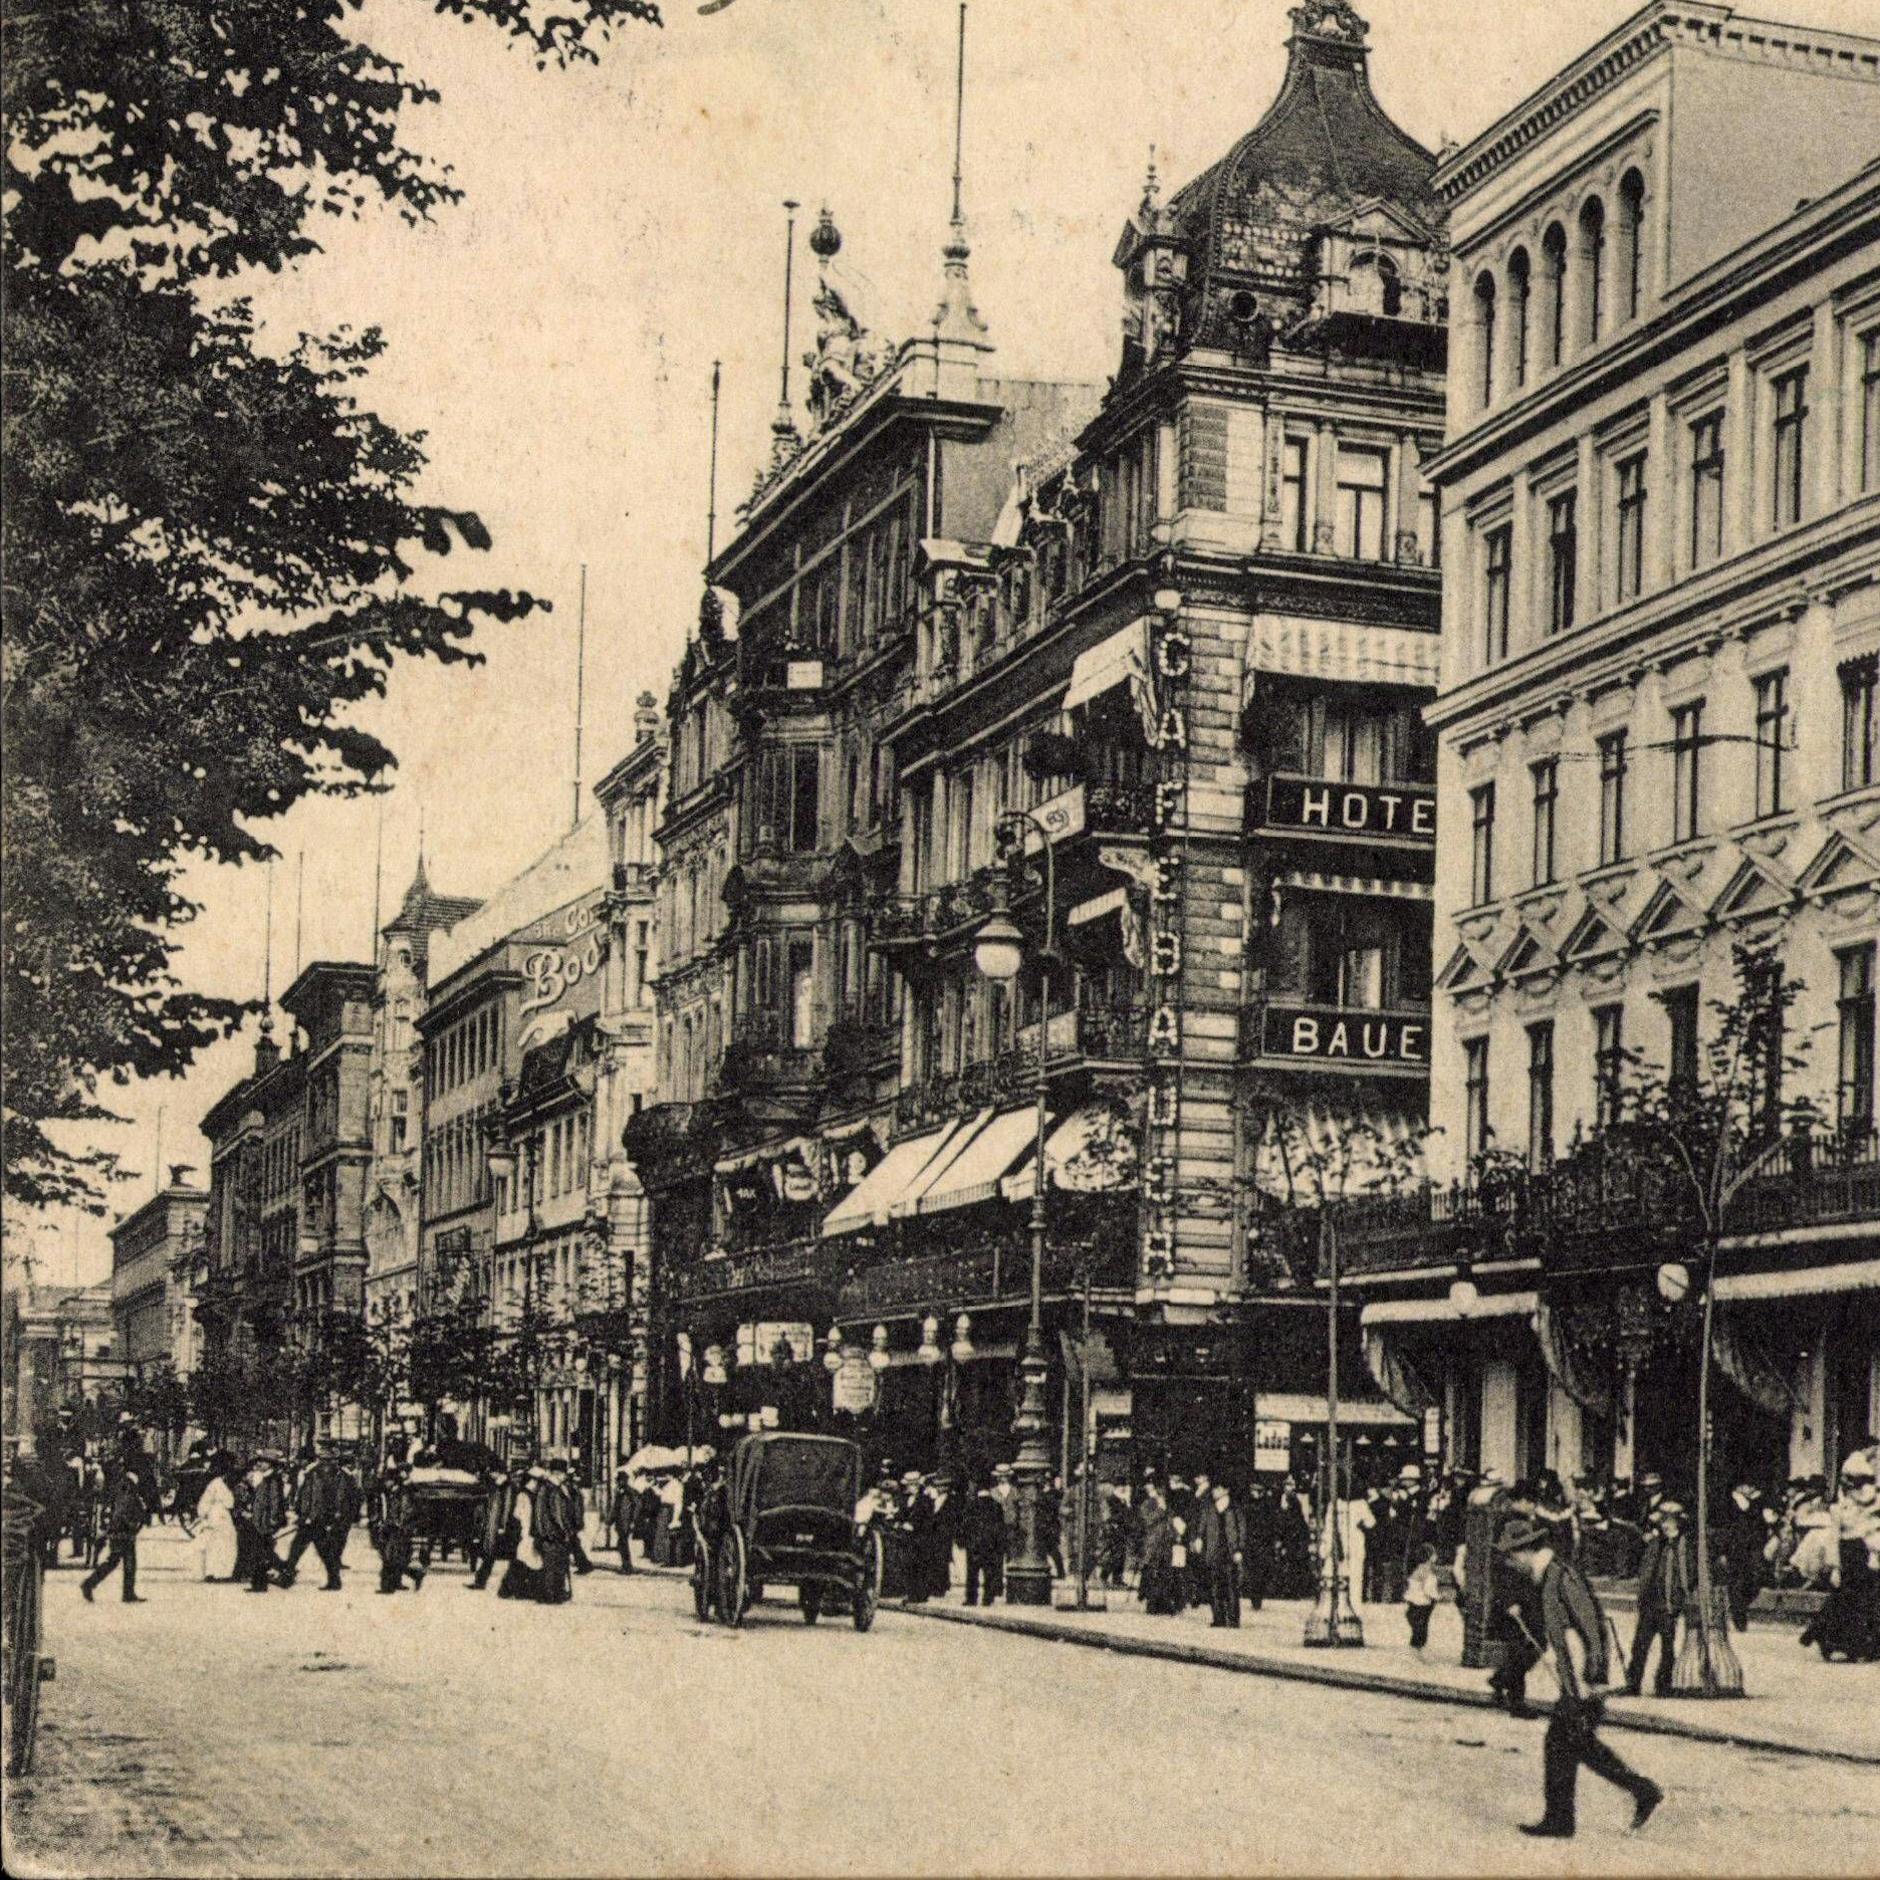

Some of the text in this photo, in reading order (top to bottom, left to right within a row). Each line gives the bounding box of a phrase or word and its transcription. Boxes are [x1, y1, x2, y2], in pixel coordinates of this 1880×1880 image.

[1302, 788, 1435, 834] HOTE
[565, 905, 594, 937] Co
[1292, 1016, 1423, 1060] BAUE
[1143, 929, 1181, 1274] BAUER
